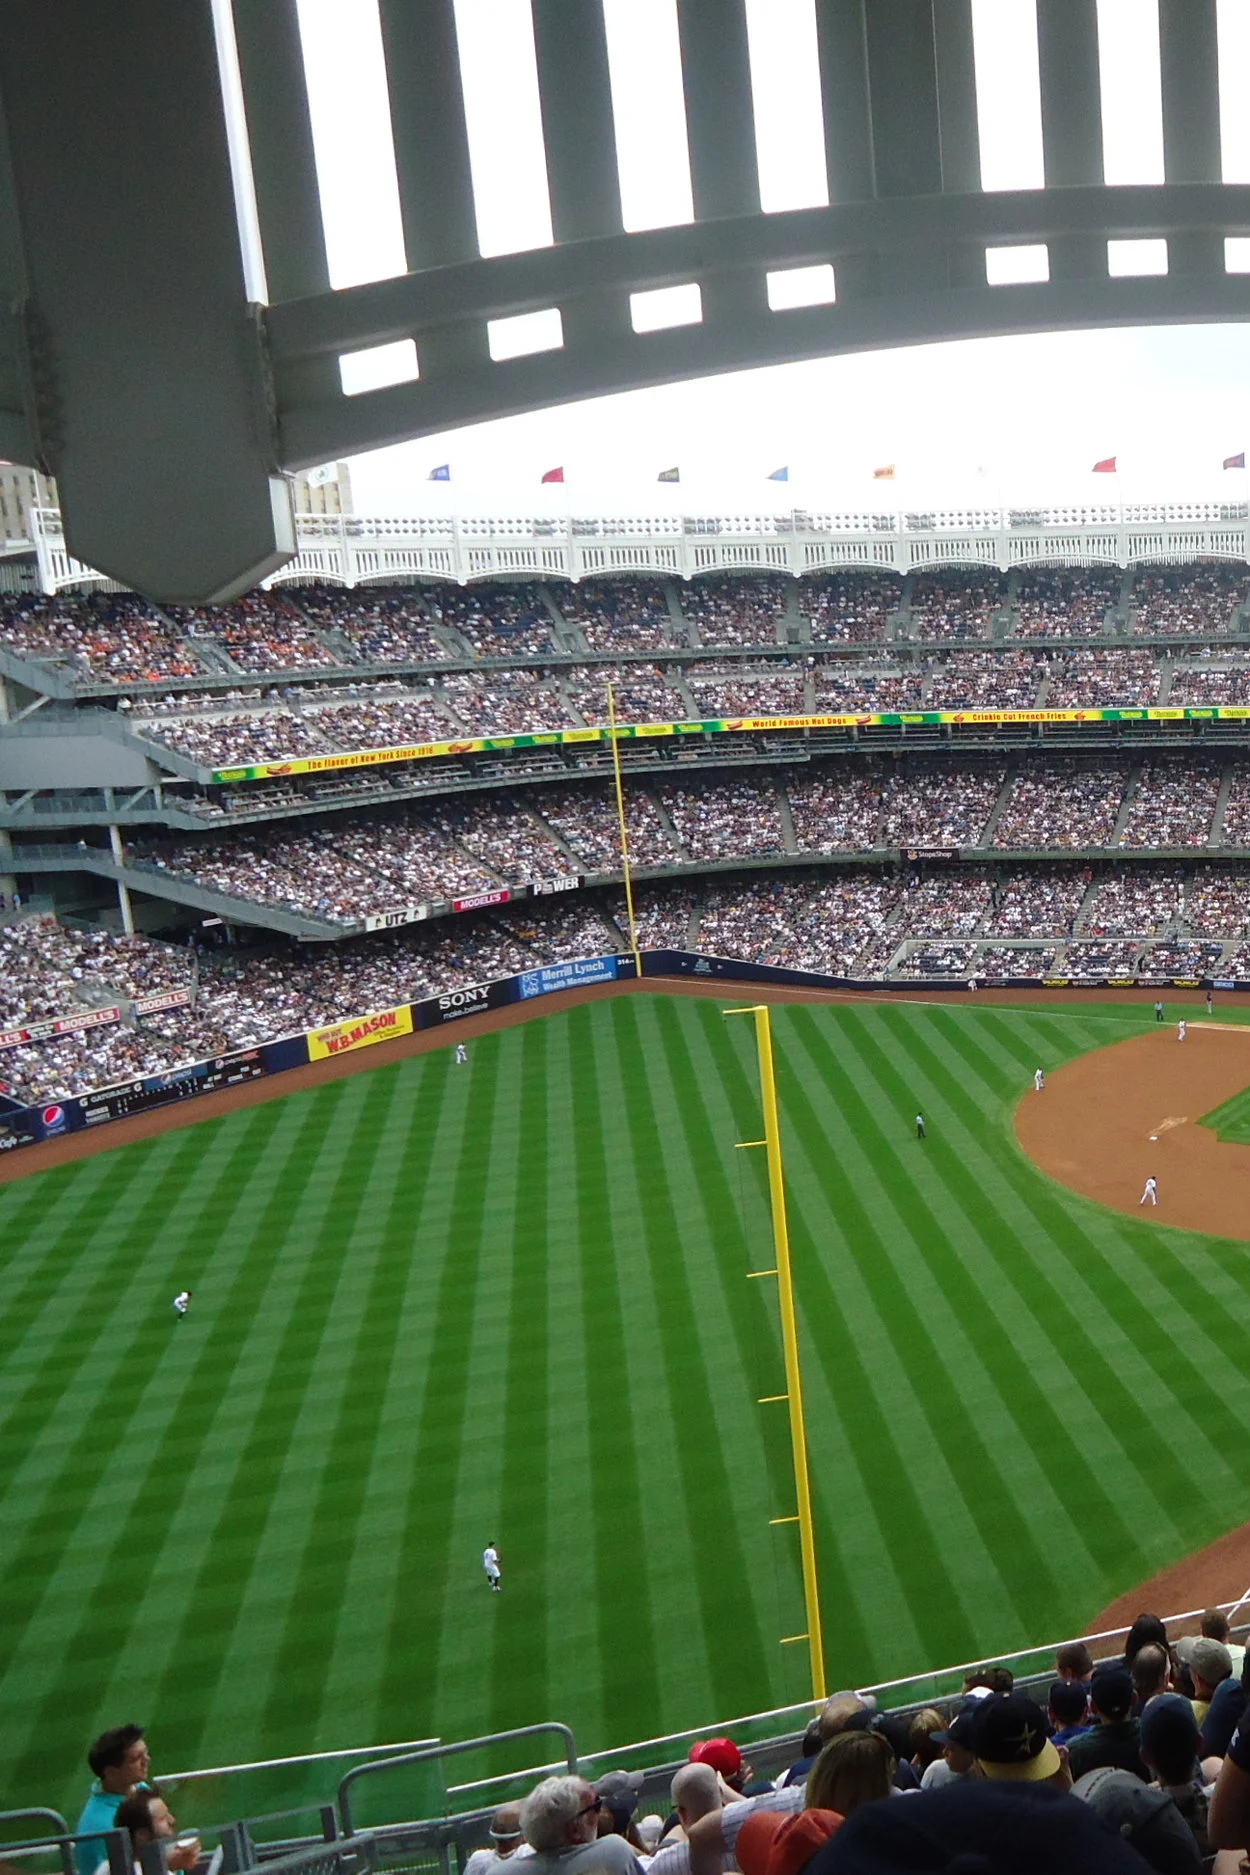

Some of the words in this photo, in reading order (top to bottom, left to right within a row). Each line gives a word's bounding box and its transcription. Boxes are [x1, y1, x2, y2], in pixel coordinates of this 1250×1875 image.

[753, 719, 776, 728] World
[779, 719, 809, 727] Famous
[812, 718, 825, 726] Hot
[827, 717, 846, 725] Dogs
[973, 713, 1001, 721] Crinkle
[1019, 712, 1044, 720] French
[308, 760, 321, 770] The
[351, 756, 359, 765] of
[361, 754, 376, 763] New
[379, 751, 394, 761] York
[396, 748, 416, 758] Since
[460, 893, 502, 909] MODELL'S
[385, 913, 409, 927] UTZ
[541, 965, 573, 981] Merrill
[575, 960, 605, 975] Lynch
[138, 993, 189, 1012] MODELL'S
[439, 986, 491, 1010] SONY
[60, 1011, 115, 1031] MODELL'S
